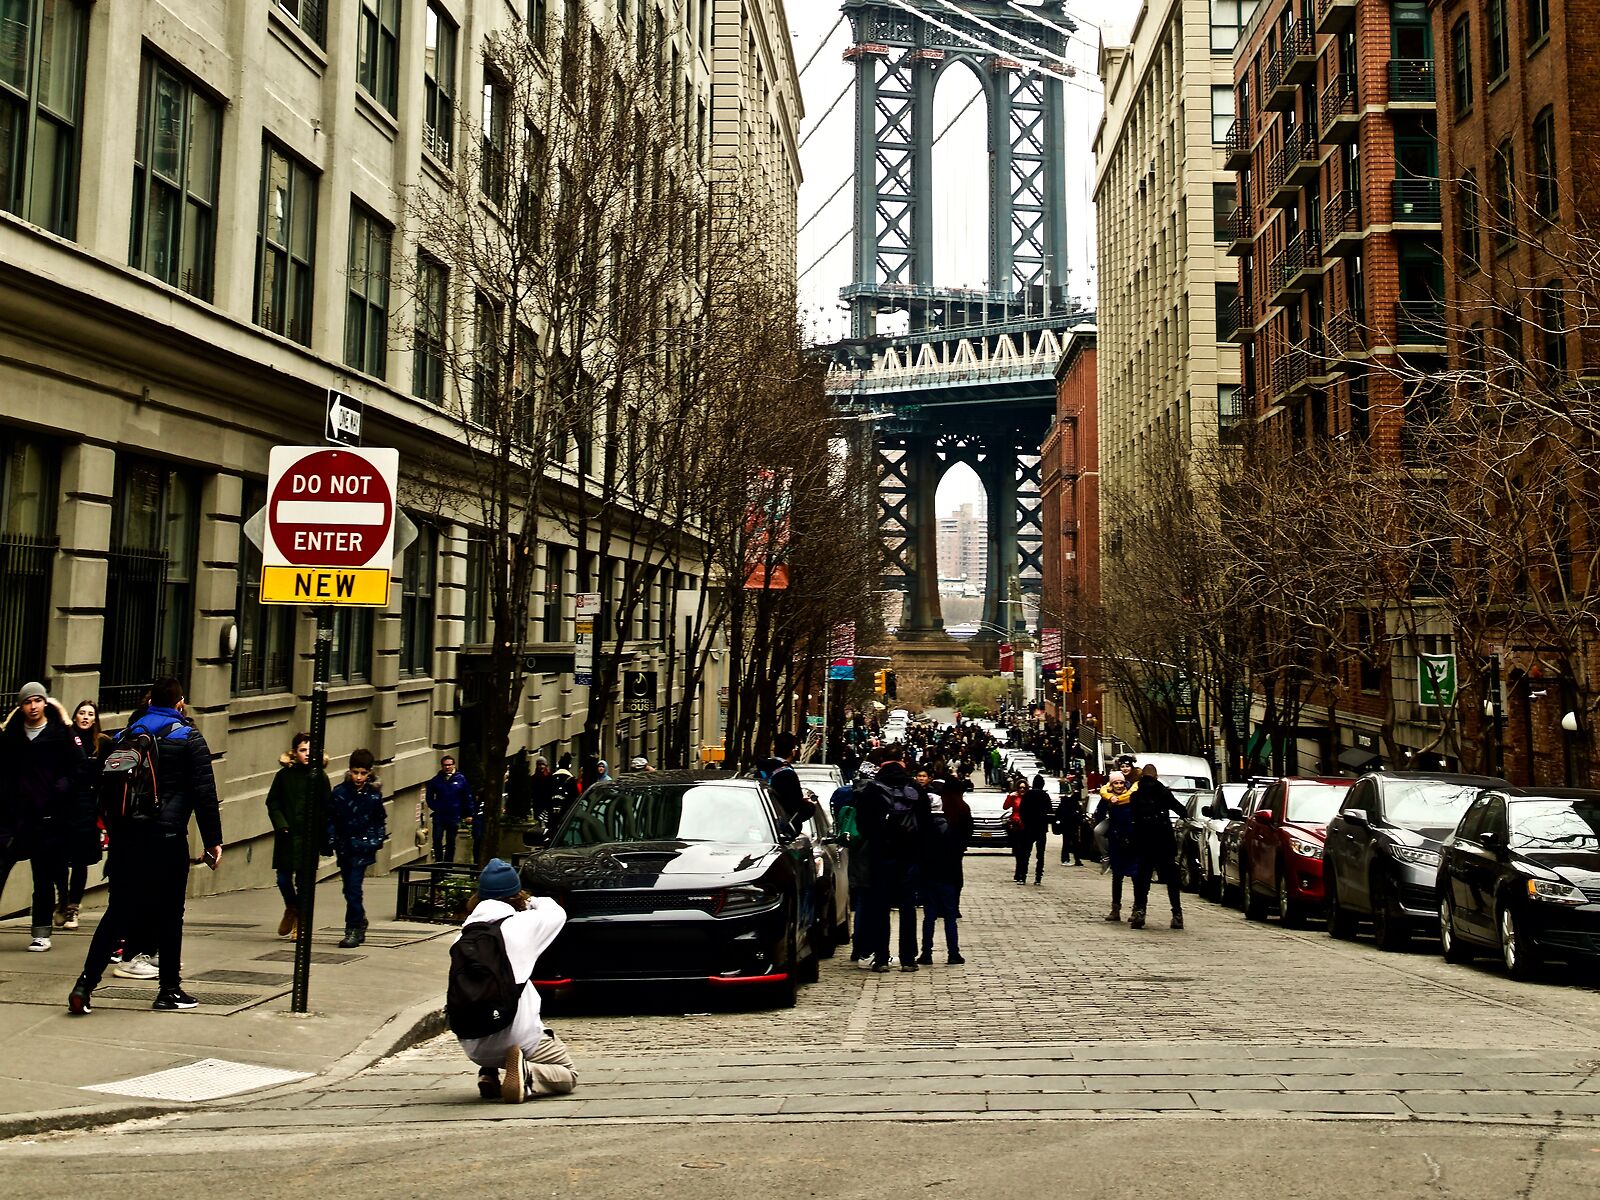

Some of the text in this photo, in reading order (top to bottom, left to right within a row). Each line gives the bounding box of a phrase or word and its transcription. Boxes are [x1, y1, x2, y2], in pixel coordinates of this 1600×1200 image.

[338, 408, 350, 429] ONE
[292, 474, 372, 495] DO NOT
[294, 531, 363, 552] ENTER
[294, 573, 356, 598] NEW
[625, 703, 655, 711] HOUSE
